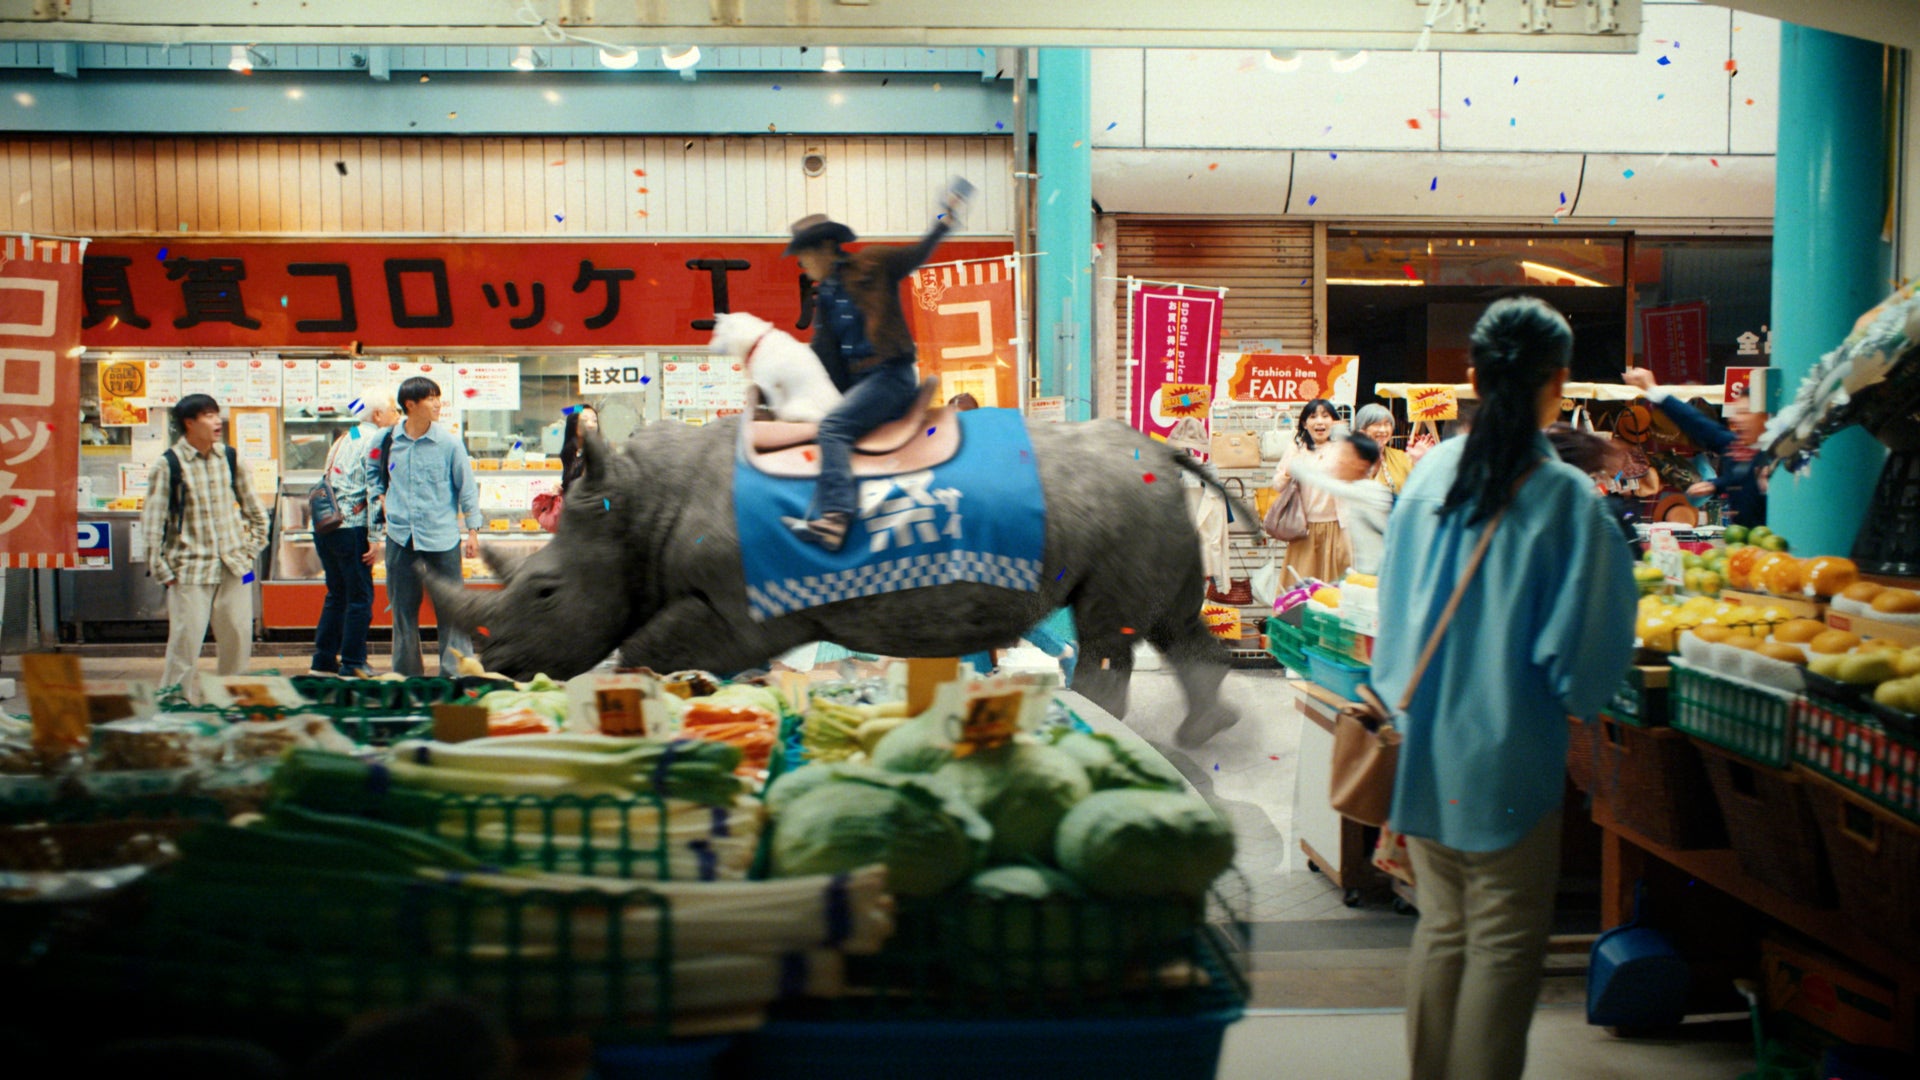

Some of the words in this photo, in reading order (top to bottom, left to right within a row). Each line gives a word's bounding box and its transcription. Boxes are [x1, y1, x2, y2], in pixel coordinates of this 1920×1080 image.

[1179, 302, 1189, 347] special
[585, 367, 639, 385] 注文口
[1177, 350, 1186, 383] price
[1251, 366, 1292, 378] Fashion
[1295, 368, 1317, 379] item
[1249, 379, 1298, 400] FAIR
